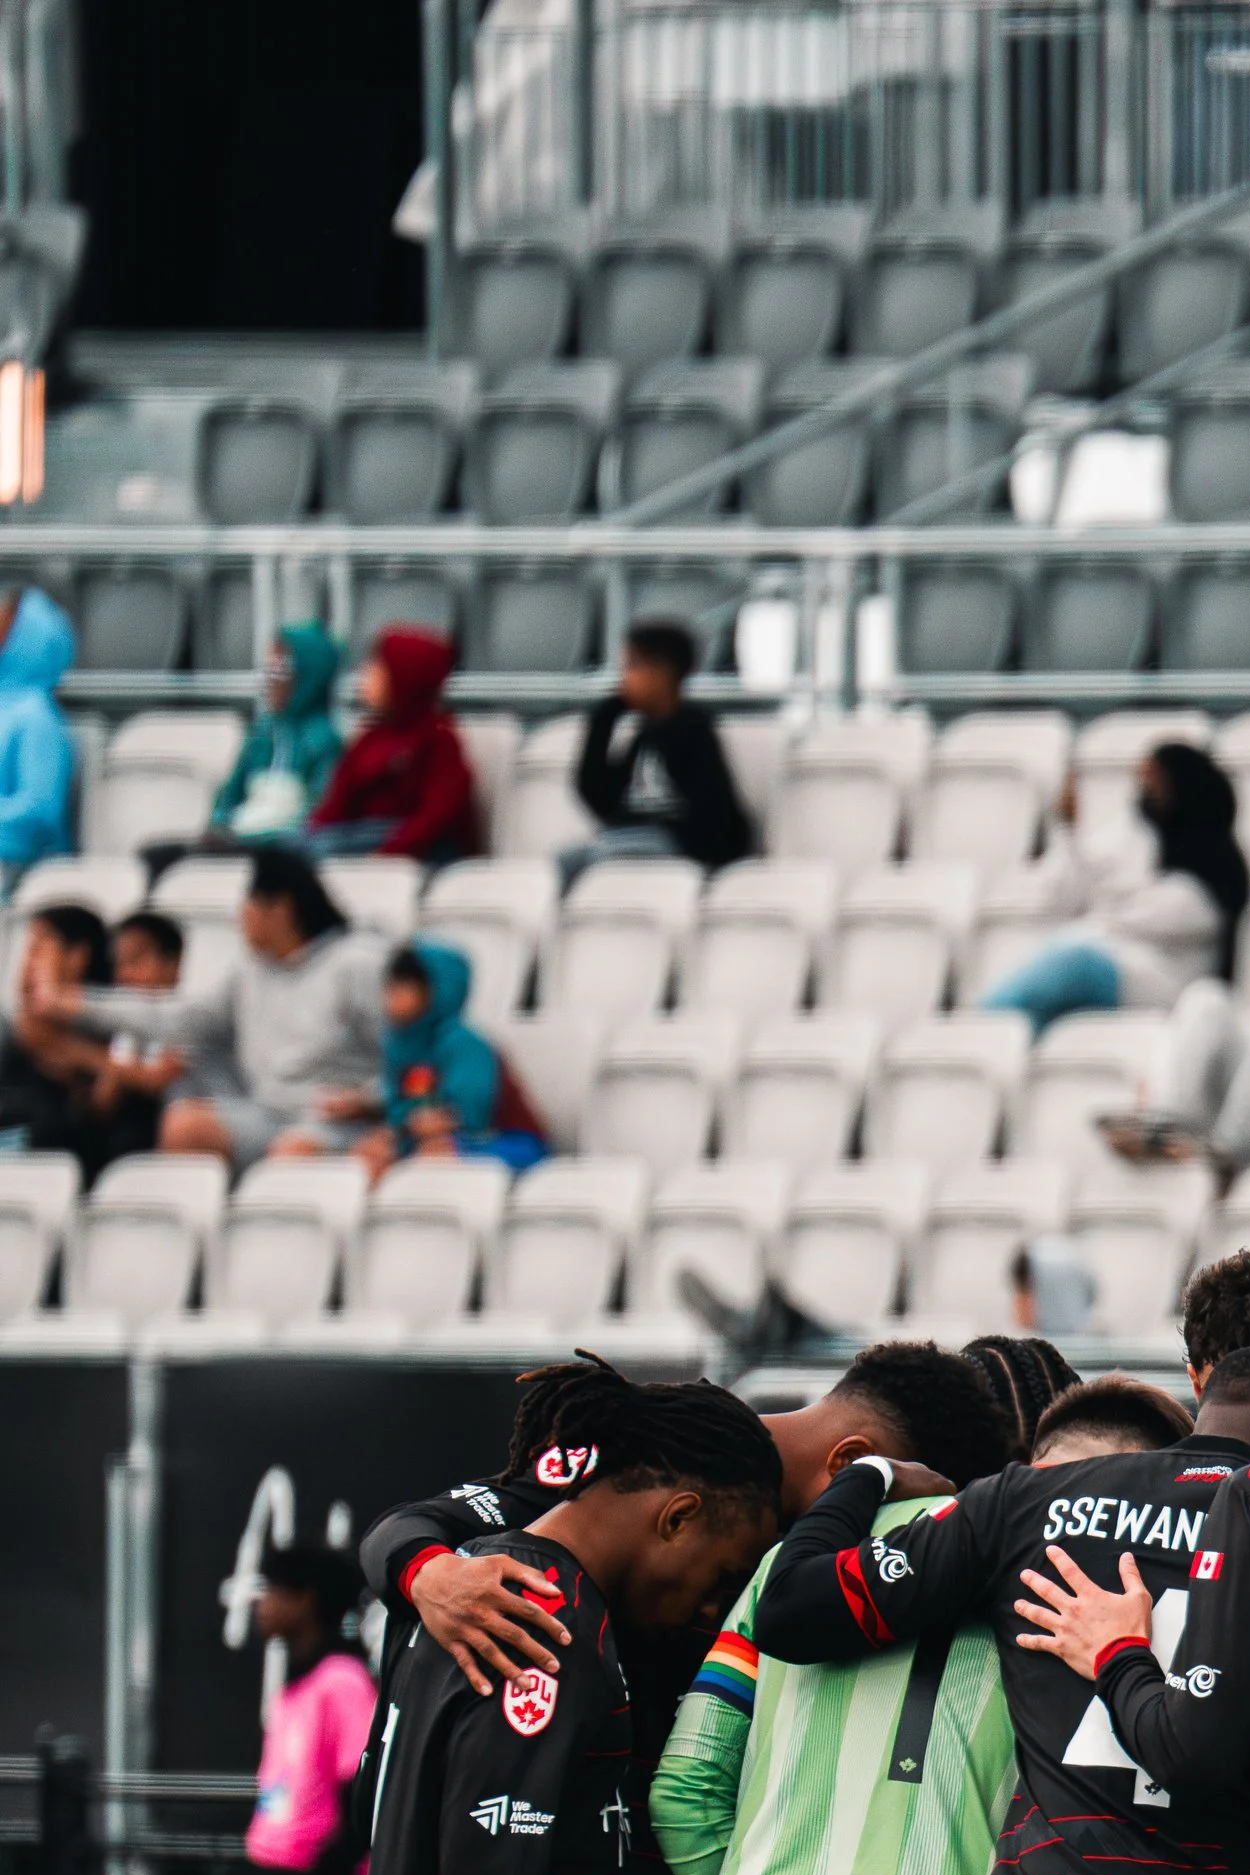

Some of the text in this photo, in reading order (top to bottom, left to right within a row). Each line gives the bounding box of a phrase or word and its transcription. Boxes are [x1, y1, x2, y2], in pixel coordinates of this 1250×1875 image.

[1043, 1497, 1208, 1552] SSEWAN
[511, 1801, 531, 1811] We
[510, 1812, 555, 1823] Master
